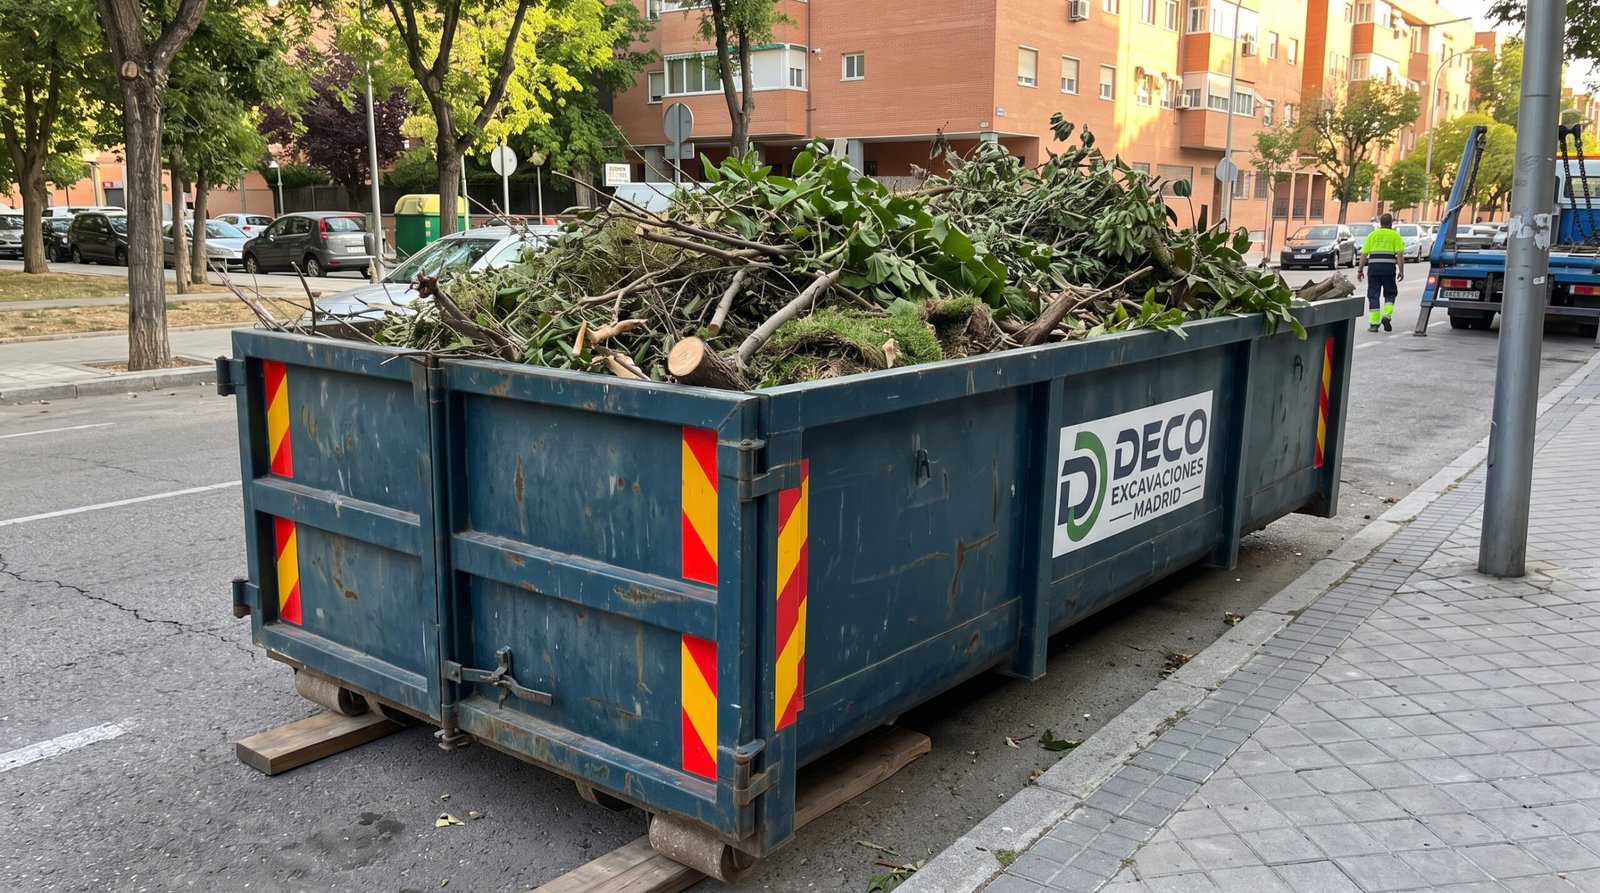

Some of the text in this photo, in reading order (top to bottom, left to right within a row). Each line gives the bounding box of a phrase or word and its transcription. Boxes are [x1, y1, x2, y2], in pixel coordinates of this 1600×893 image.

[1113, 408, 1207, 481] DECO
[1111, 457, 1204, 506] EXCAVACIONES
[1133, 487, 1181, 520] MADRID
